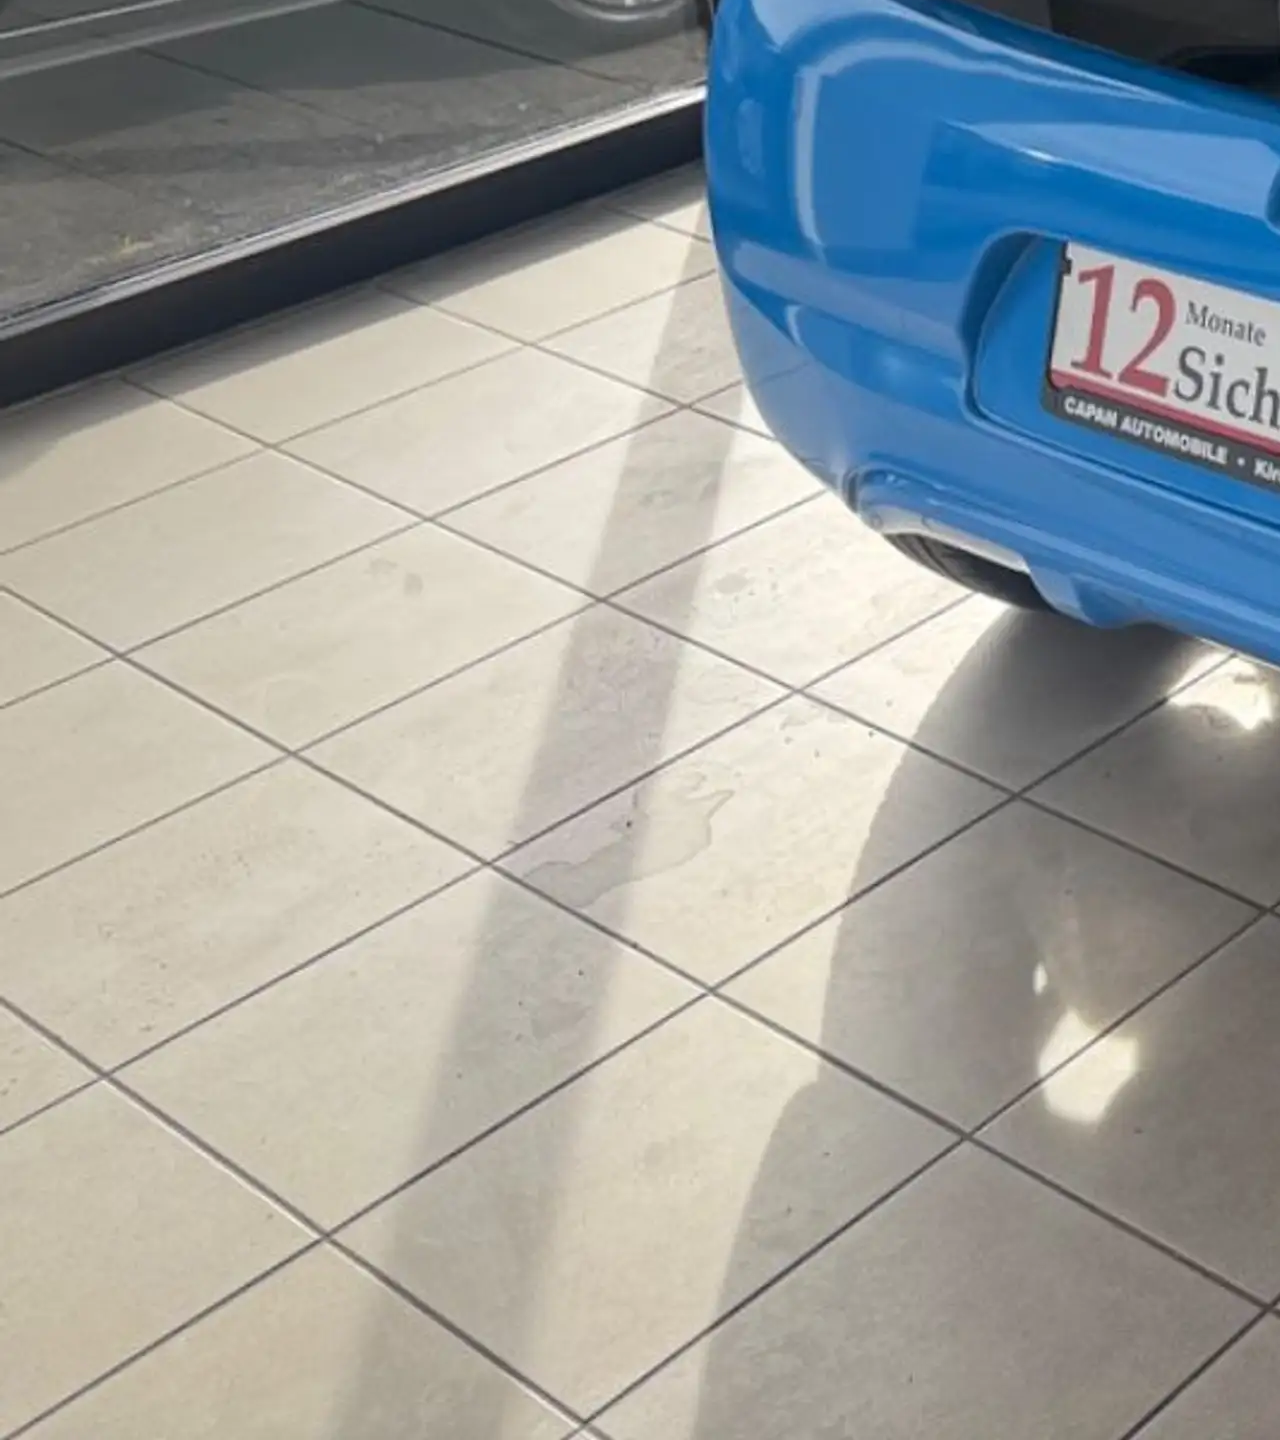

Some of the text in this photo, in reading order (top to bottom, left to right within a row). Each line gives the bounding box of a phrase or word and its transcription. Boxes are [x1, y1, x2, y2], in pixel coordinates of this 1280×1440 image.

[1070, 264, 1177, 398] 12
[1185, 300, 1267, 347] Monate
[1063, 395, 1119, 428] CAPAN
[1119, 415, 1229, 465] AUTOMOBILE
